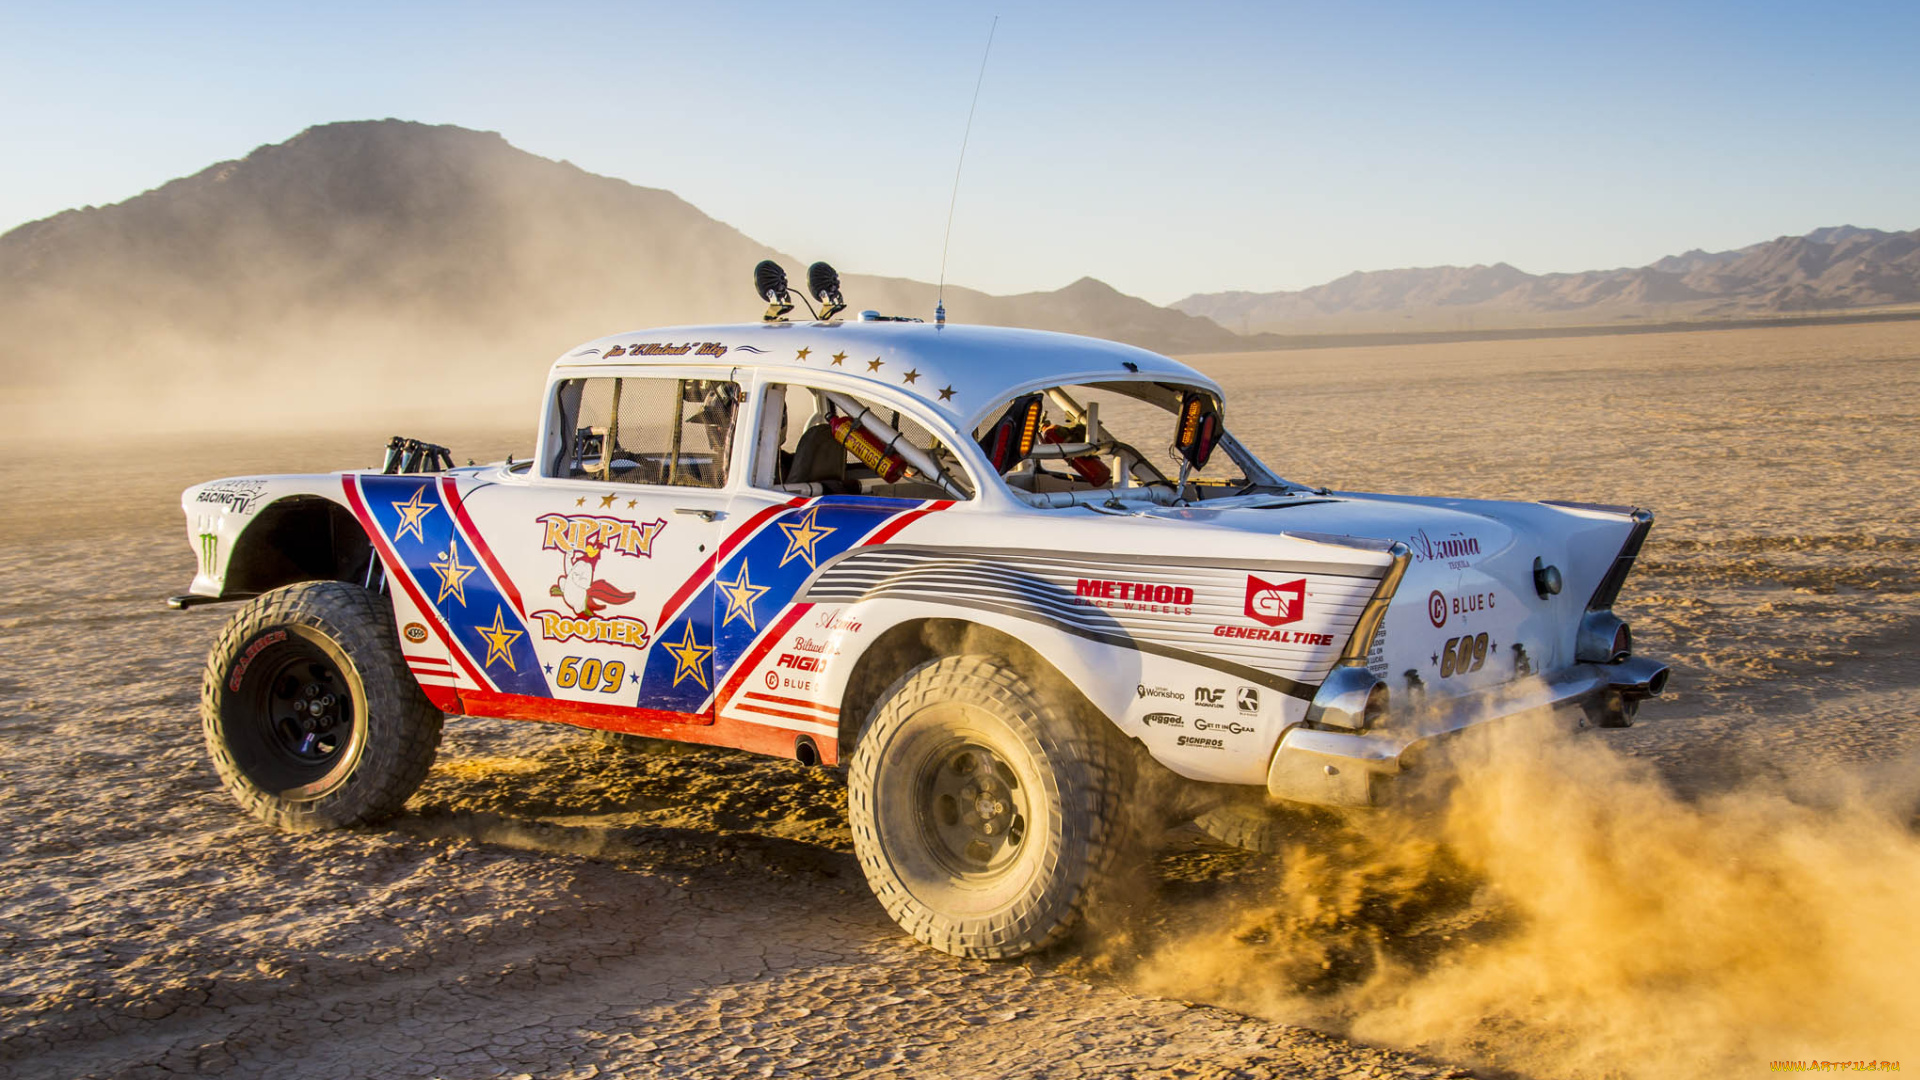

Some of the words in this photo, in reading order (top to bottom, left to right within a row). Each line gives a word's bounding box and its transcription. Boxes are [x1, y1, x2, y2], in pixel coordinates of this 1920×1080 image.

[196, 492, 235, 504] RACING
[230, 497, 251, 513] TV
[536, 513, 667, 558] RIPPIN'
[1448, 560, 1470, 571] TEQUILA
[1077, 579, 1194, 606] METHOD
[1453, 594, 1484, 614] BLUE
[1488, 592, 1496, 609] C
[1074, 598, 1114, 609] RACE
[1123, 602, 1192, 616] WHEELS
[530, 610, 651, 650] ROOSTER
[1213, 625, 1291, 643] GENERAL
[1293, 633, 1334, 646] TIRE
[230, 631, 287, 692] GRABBER
[776, 653, 828, 673] RIGID
[1440, 632, 1489, 679] 609
[556, 655, 626, 694] 609
[784, 678, 811, 691] BLUE
[1146, 688, 1185, 701] Workshop
